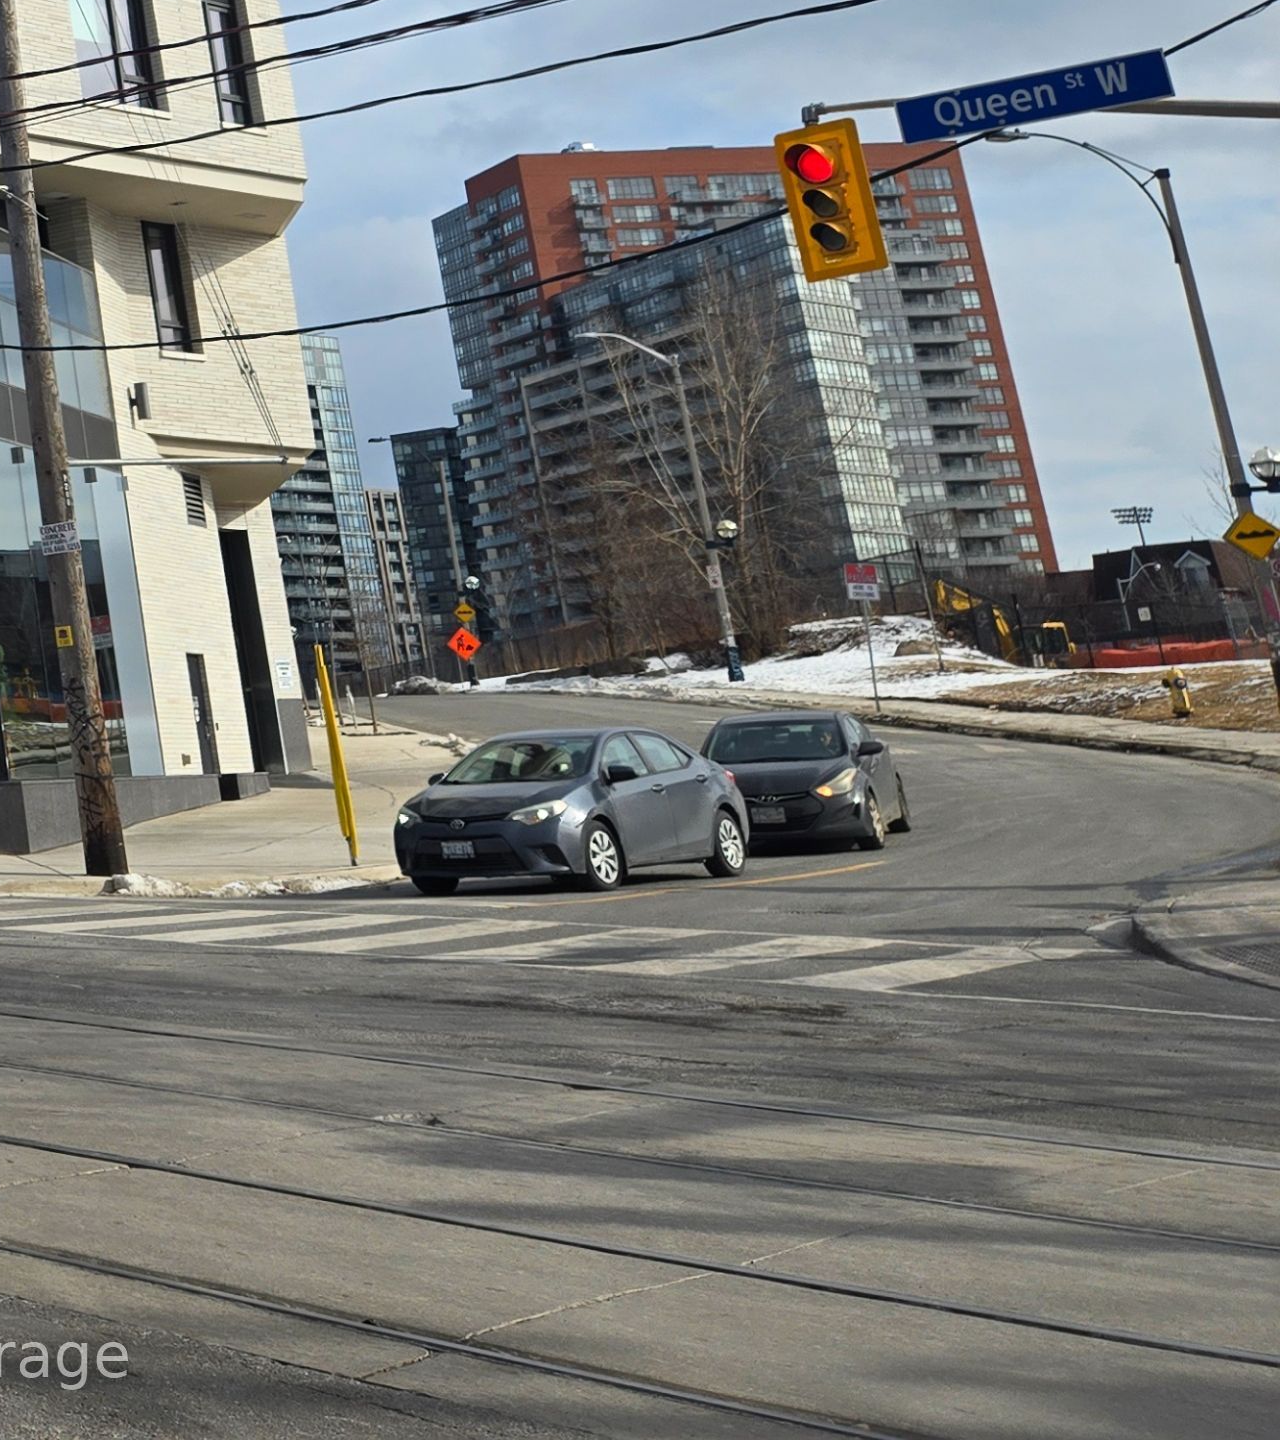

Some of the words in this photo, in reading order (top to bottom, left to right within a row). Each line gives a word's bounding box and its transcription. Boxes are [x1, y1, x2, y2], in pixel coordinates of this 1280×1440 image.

[933, 83, 1057, 128] Queen
[1063, 71, 1086, 90] St
[1094, 61, 1128, 97] W
